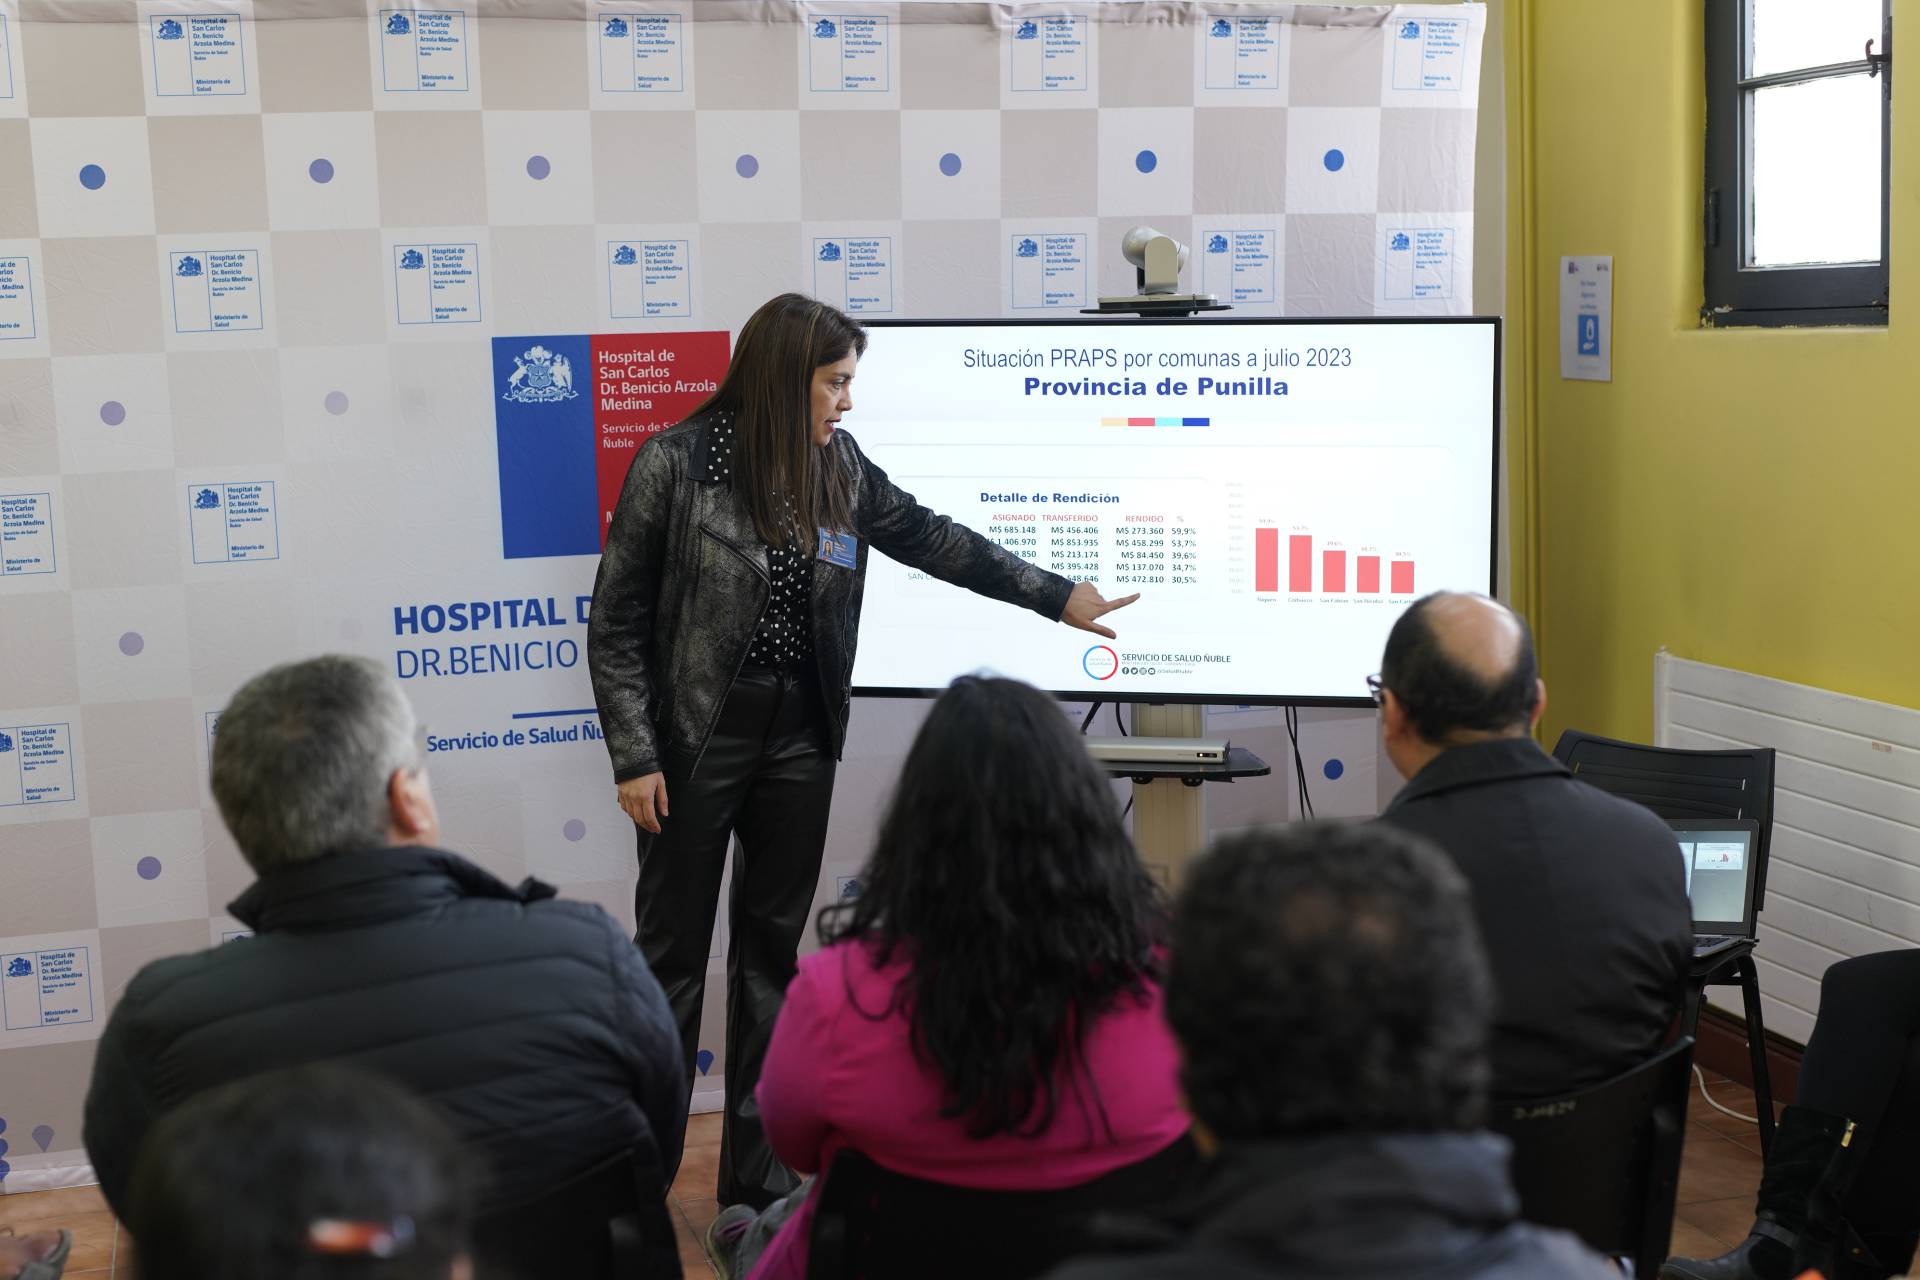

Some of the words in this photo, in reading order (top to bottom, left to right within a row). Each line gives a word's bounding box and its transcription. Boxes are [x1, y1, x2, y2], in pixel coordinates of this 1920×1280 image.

[599, 351, 655, 365] Hospital
[658, 350, 675, 361] de
[964, 349, 1044, 368] Situación
[1051, 349, 1117, 367] PRAPS
[1124, 354, 1154, 372] por
[1159, 352, 1240, 367] comunas
[1247, 354, 1257, 367] a
[1262, 349, 1299, 371] julio
[1307, 349, 1351, 367] 2023
[600, 368, 624, 379] San
[628, 366, 669, 377] Carlos
[601, 383, 619, 395] Dr.
[622, 381, 671, 394] Benicio
[675, 380, 717, 392] Arzola
[1025, 377, 1147, 395] Provincia
[1156, 377, 1188, 395] de
[1198, 377, 1288, 395] Punilla
[601, 398, 652, 410] Medina
[602, 424, 644, 434] Servicio
[648, 422, 661, 432] de
[603, 437, 634, 448] Ñuble
[980, 493, 1028, 502] Detalle
[1032, 493, 1048, 502] de
[1052, 493, 1120, 503] Rendición
[989, 526, 1002, 534] M$
[1051, 526, 1064, 535] M$
[1066, 526, 1098, 535] 456.406
[1116, 527, 1129, 535] M$
[1116, 539, 1129, 547] M$
[1172, 540, 1196, 548] 53,7%
[1121, 551, 1134, 559] M$
[1172, 552, 1196, 560] 39,6%
[1052, 562, 1064, 570] M$
[1172, 564, 1196, 572] 34,7%
[1116, 575, 1129, 583] M$
[1172, 576, 1196, 584] 30,5%
[394, 598, 566, 635] HOSPITAL
[576, 596, 593, 624] D
[397, 639, 577, 678] DR.BENICIO
[1204, 653, 1231, 662] ÑUBLE
[427, 732, 498, 752] Servicio
[503, 730, 524, 746] de
[529, 725, 578, 743] Salud
